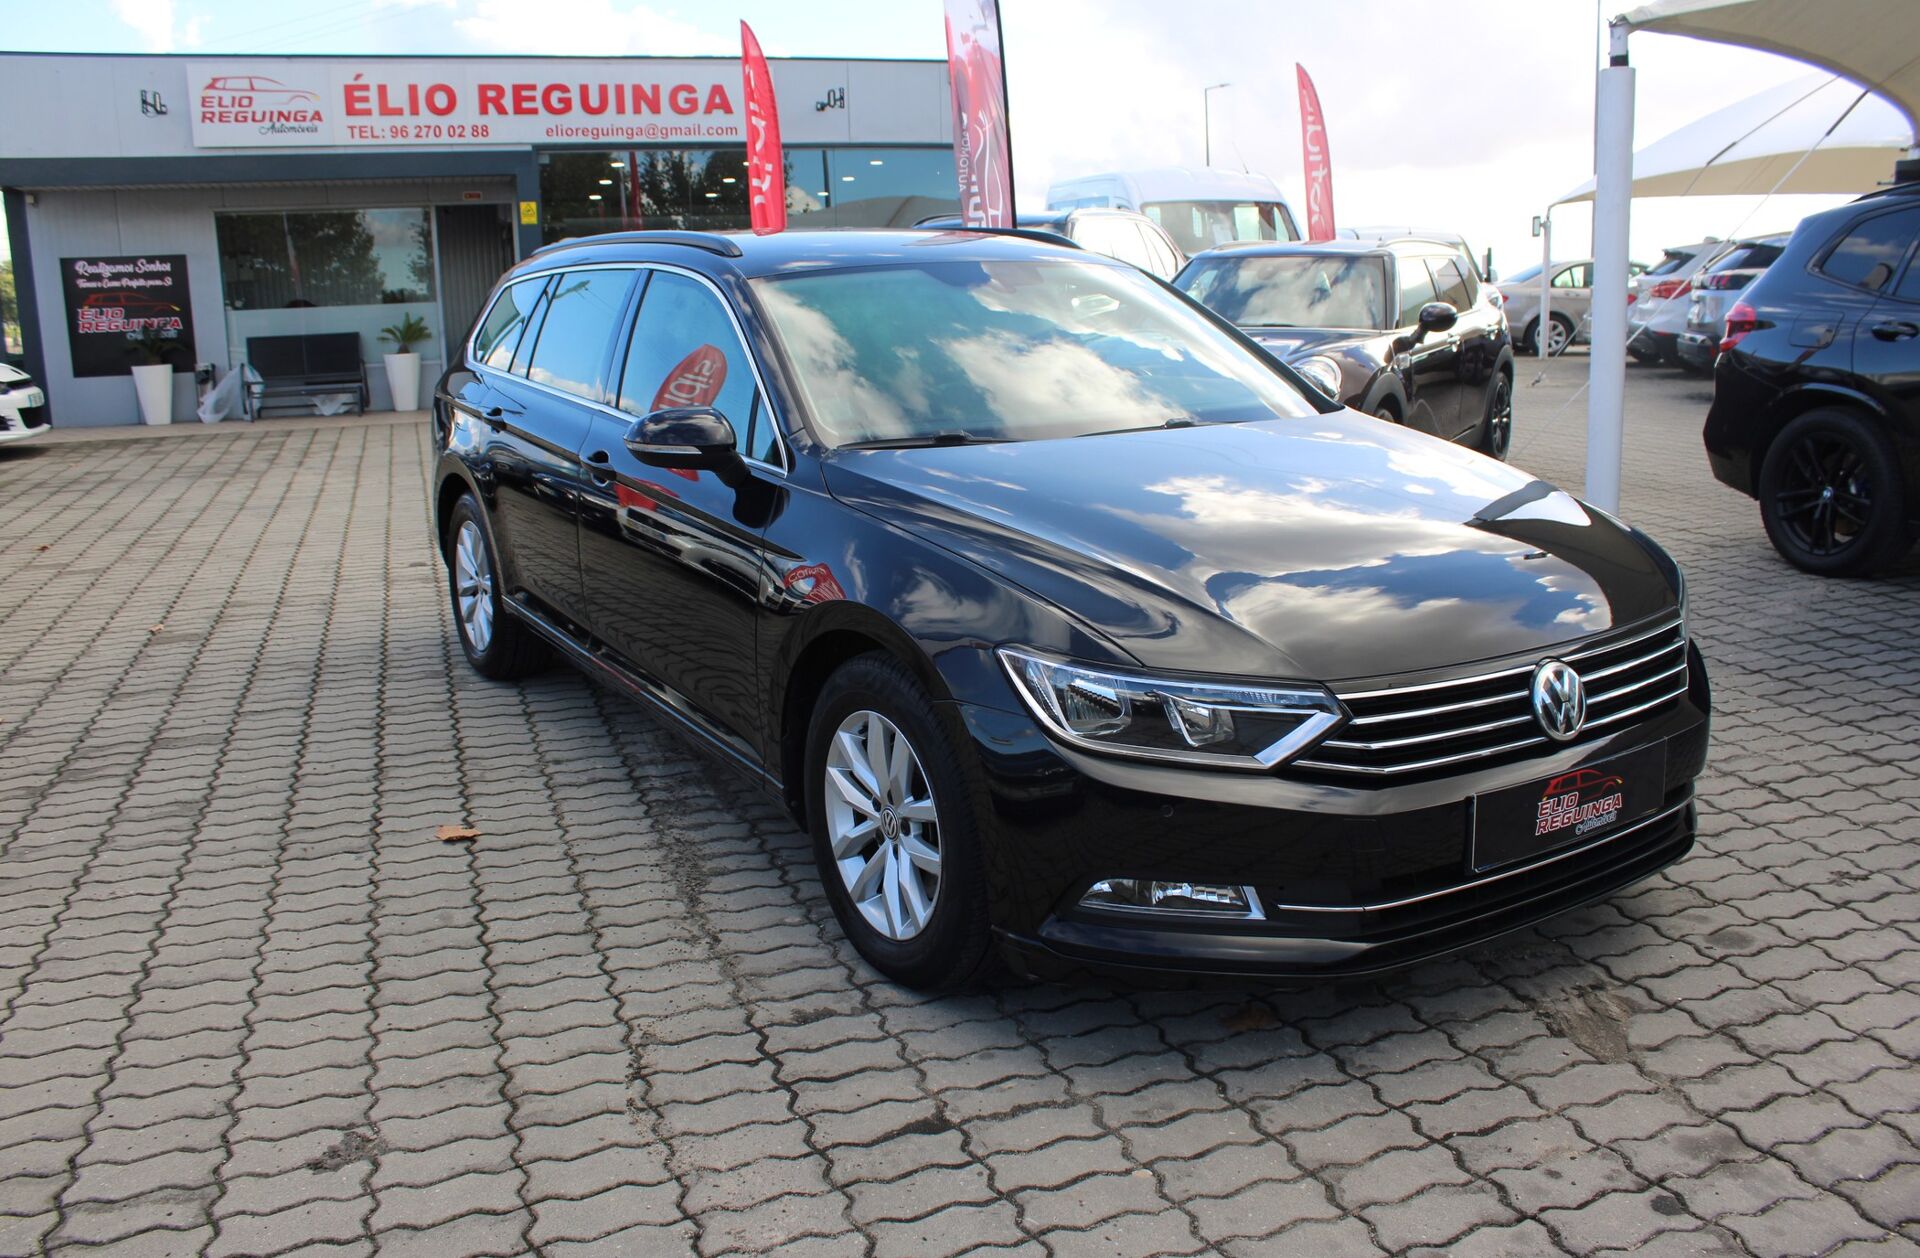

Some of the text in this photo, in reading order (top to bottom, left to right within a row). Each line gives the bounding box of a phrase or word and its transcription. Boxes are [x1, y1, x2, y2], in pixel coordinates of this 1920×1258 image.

[201, 95, 254, 108] ELIO
[343, 73, 734, 116] ÉLIO REGUINGA
[201, 110, 323, 123] REGUINGA
[347, 124, 489, 139] TEL: 96 270 02 88
[545, 123, 738, 140] elioreguinga@gmail.com
[77, 307, 125, 320] ELIO
[1537, 791, 1579, 818] ELIO
[1535, 793, 1622, 836] REGUINGA
